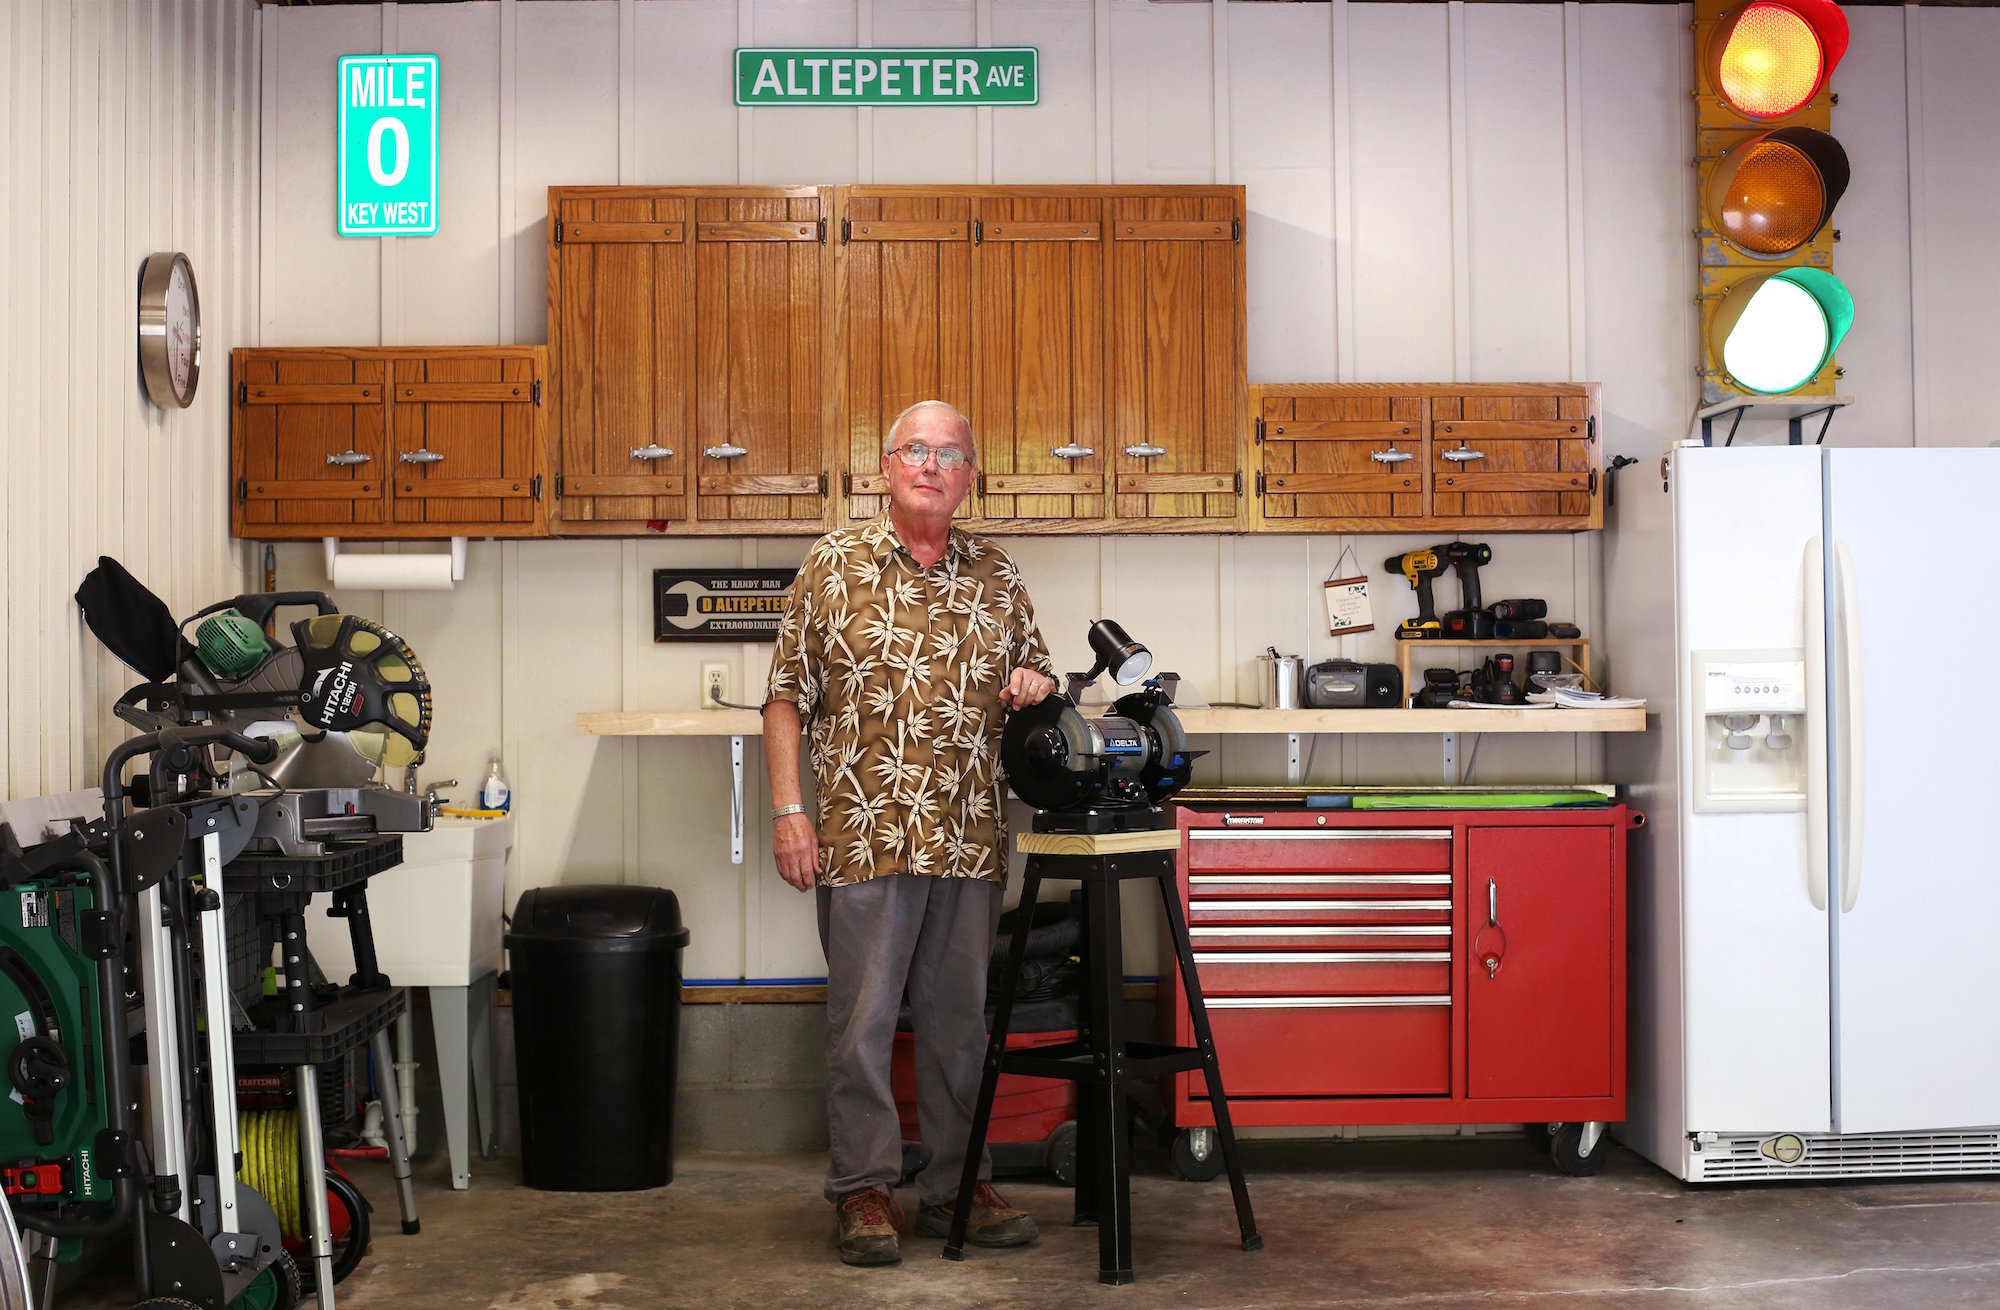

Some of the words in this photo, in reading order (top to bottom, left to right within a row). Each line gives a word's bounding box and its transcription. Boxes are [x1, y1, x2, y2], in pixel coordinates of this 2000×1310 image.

[351, 65, 426, 108] MILE
[751, 58, 981, 96] ALTEPETER
[985, 65, 1025, 87] AVE
[367, 116, 410, 187] 0
[348, 202, 379, 225] KEY
[383, 201, 429, 225] WEST
[710, 580, 729, 589] THE
[731, 580, 760, 589] HANDY
[762, 580, 781, 589] MAN
[702, 597, 713, 612] D
[320, 660, 353, 725] HITACHI
[1115, 739, 1138, 747] DELTA
[81, 1150, 92, 1196] HITACHI
